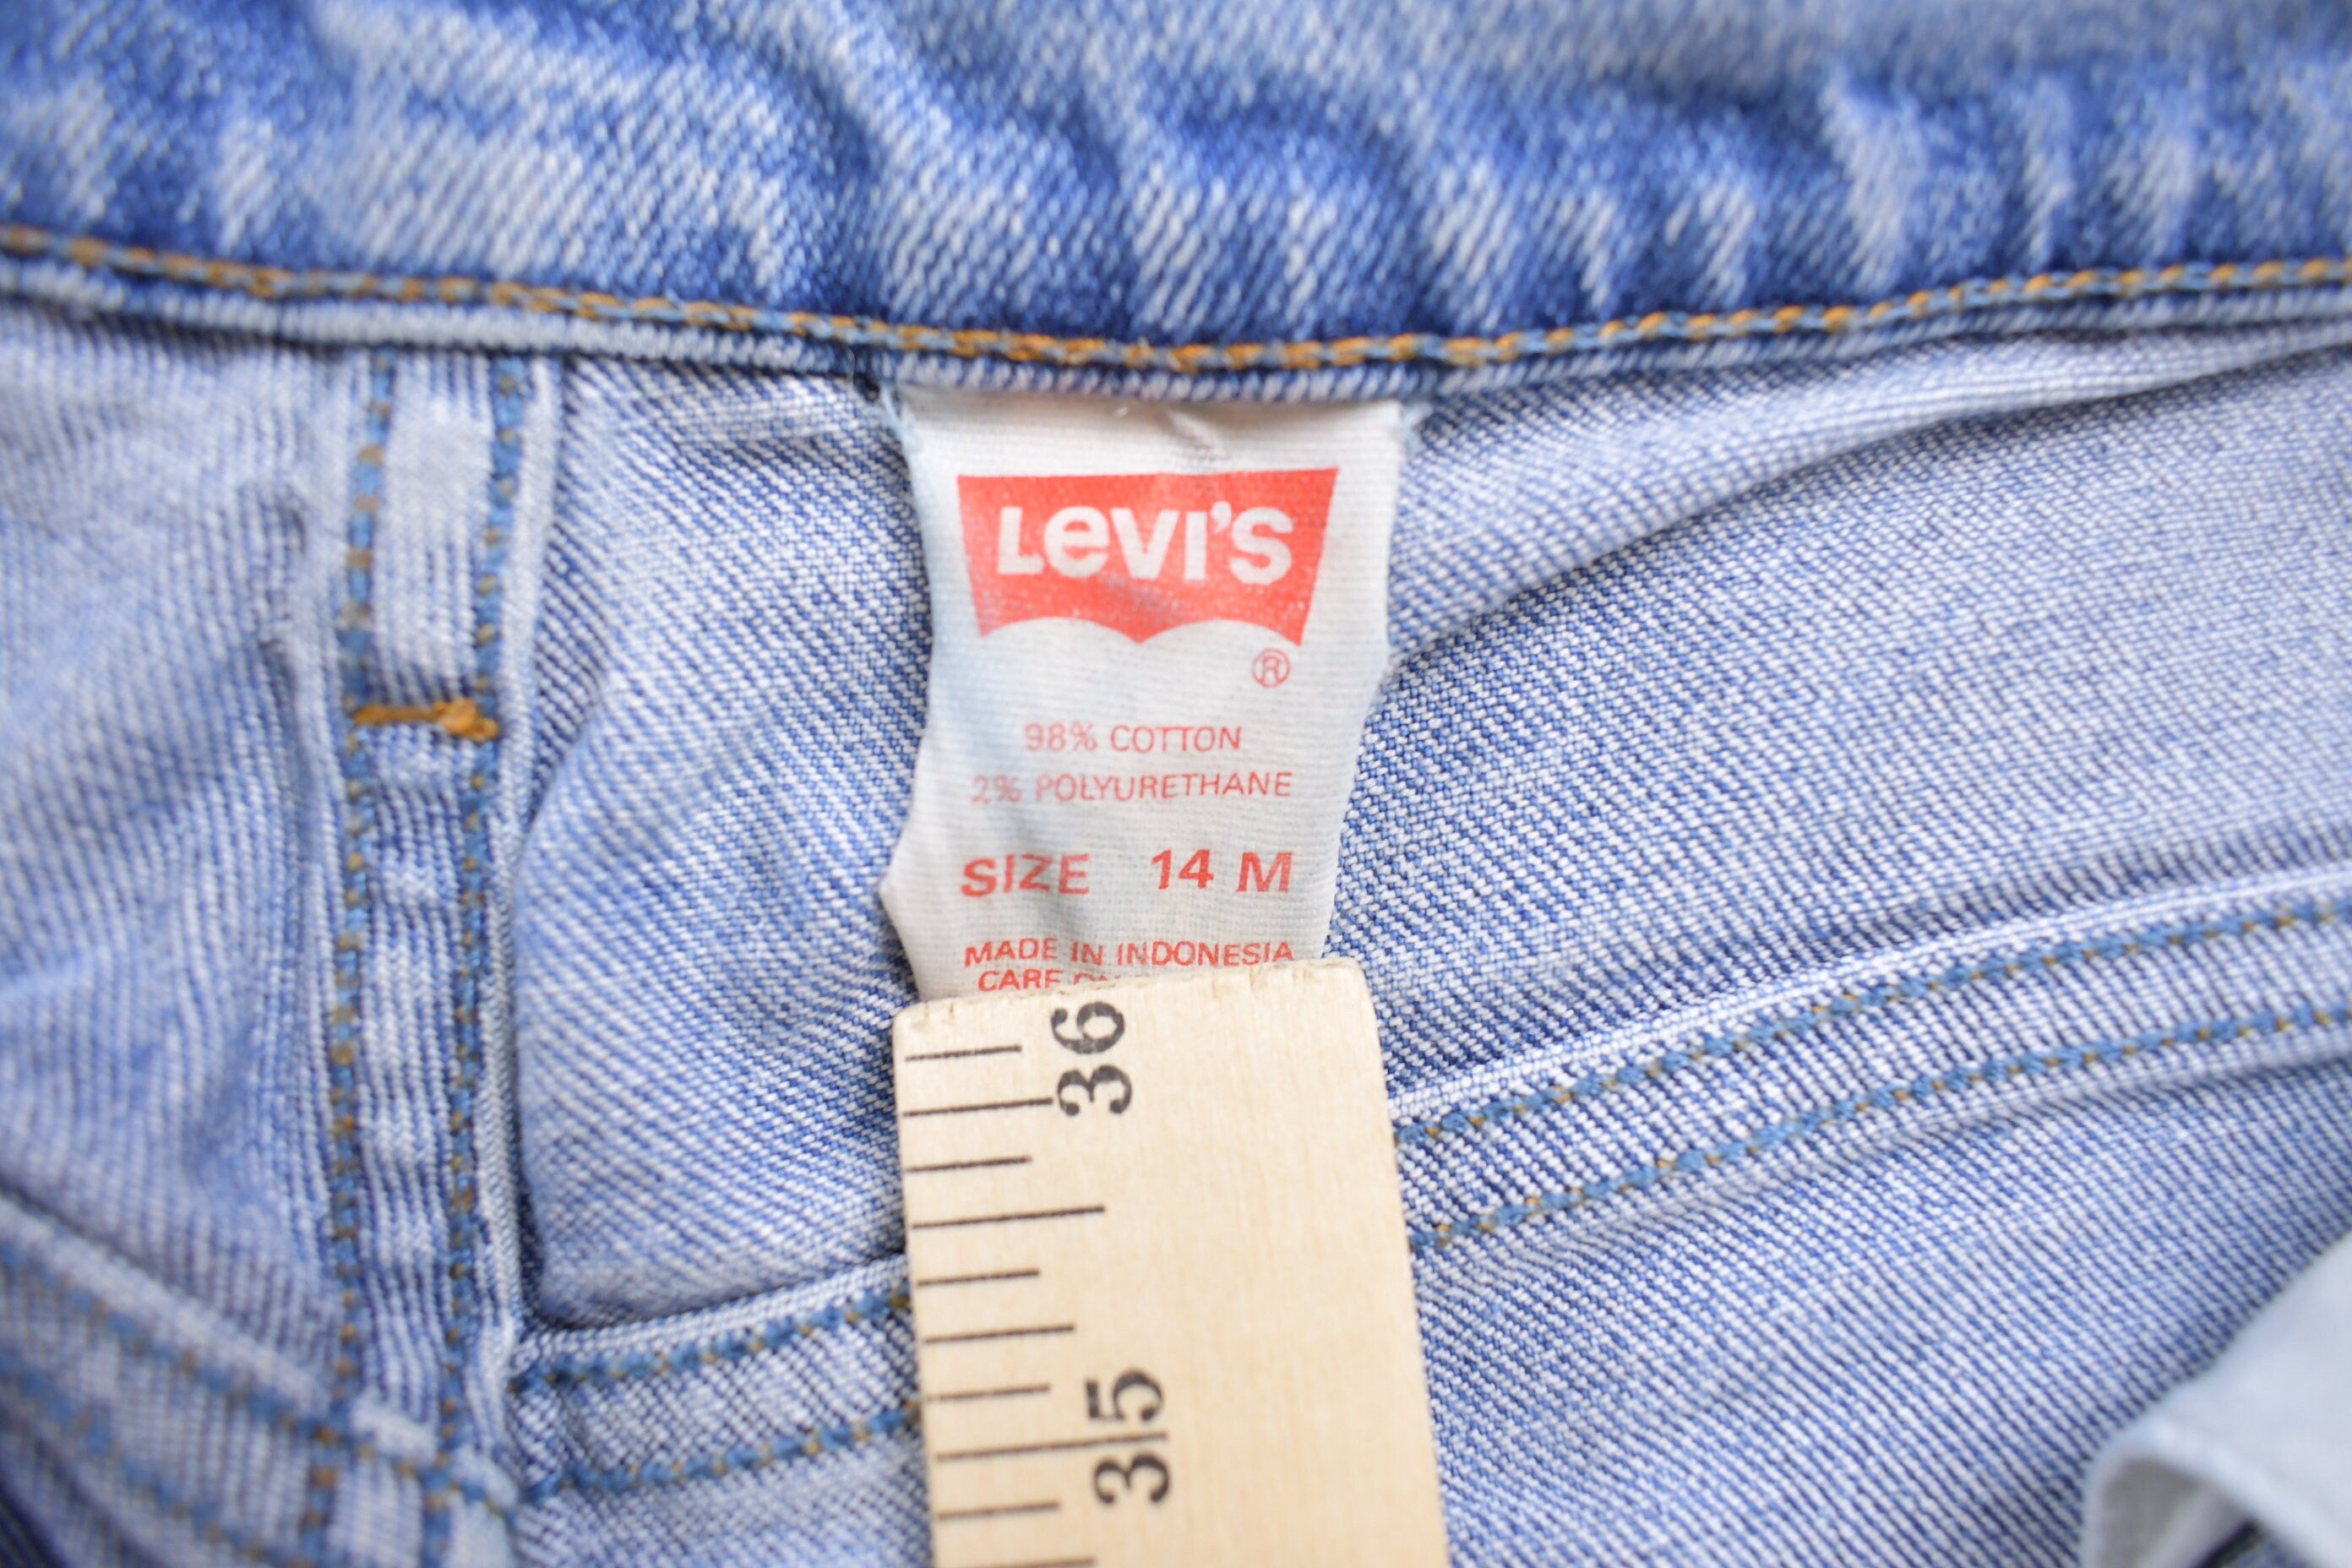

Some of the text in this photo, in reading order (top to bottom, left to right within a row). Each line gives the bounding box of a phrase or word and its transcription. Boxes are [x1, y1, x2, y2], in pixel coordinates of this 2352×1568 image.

[1024, 722, 1243, 754] 98% COTTON
[971, 772, 1293, 804] 2% POLYURETHANE
[961, 849, 1294, 897] SIZE 14 M
[964, 938, 1295, 967] MADE IN INDONESIA
[1050, 1000, 1134, 1118] 36
[1085, 1368, 1171, 1506] 35
